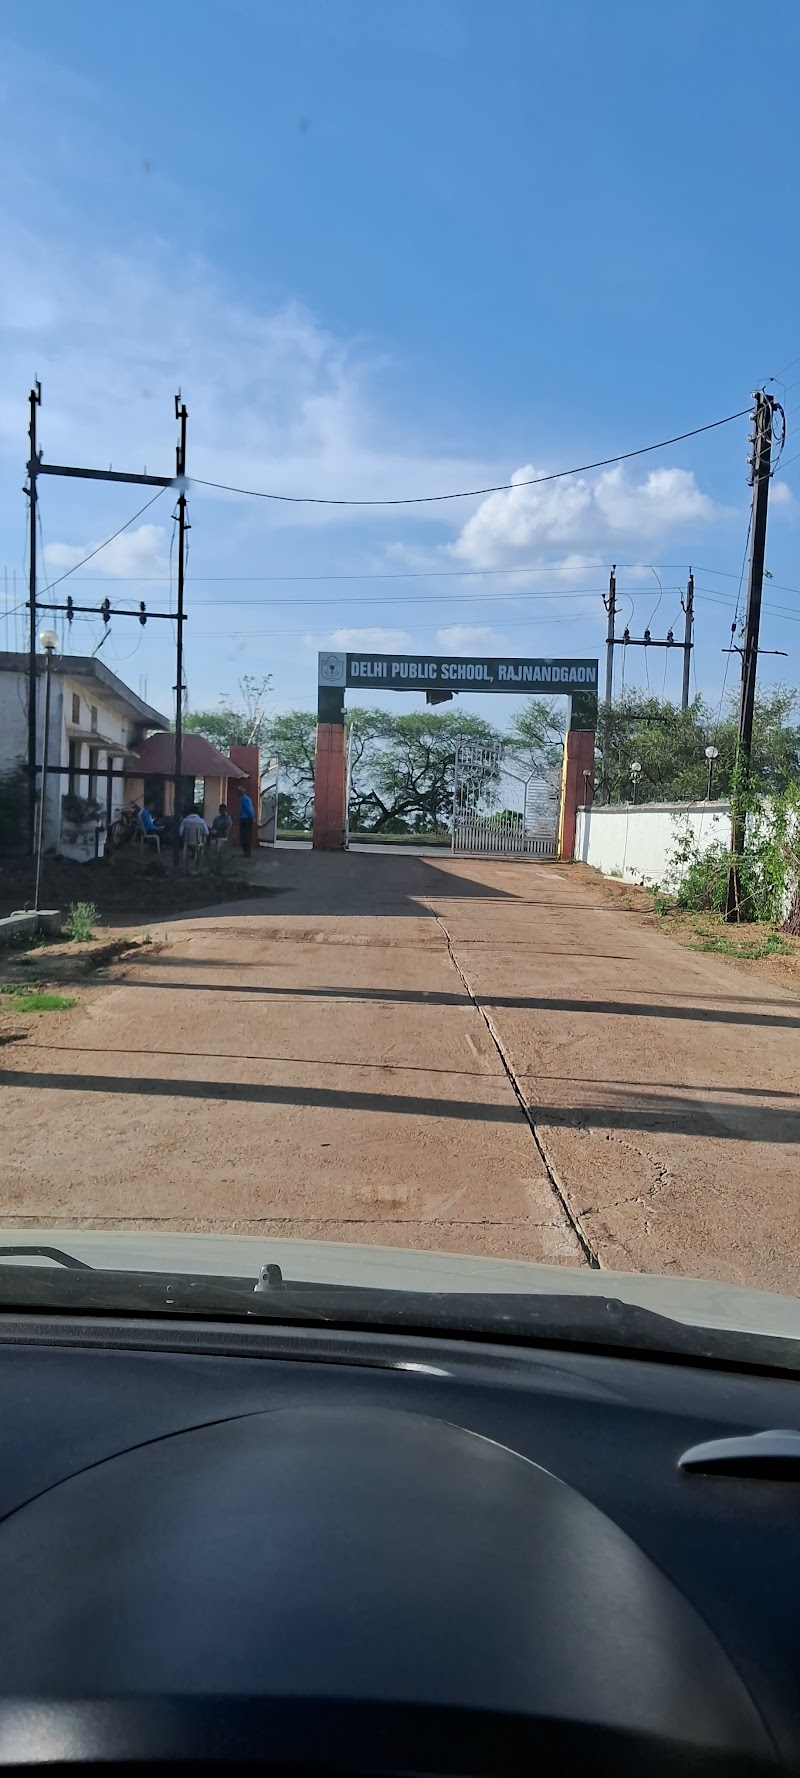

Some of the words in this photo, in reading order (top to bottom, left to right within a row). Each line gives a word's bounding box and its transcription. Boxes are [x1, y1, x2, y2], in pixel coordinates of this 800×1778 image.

[351, 661, 387, 677] DELHI
[391, 662, 437, 679] PUBLIC
[441, 664, 494, 683] SCHOOL,
[498, 665, 596, 683] RAJNANDGAON
